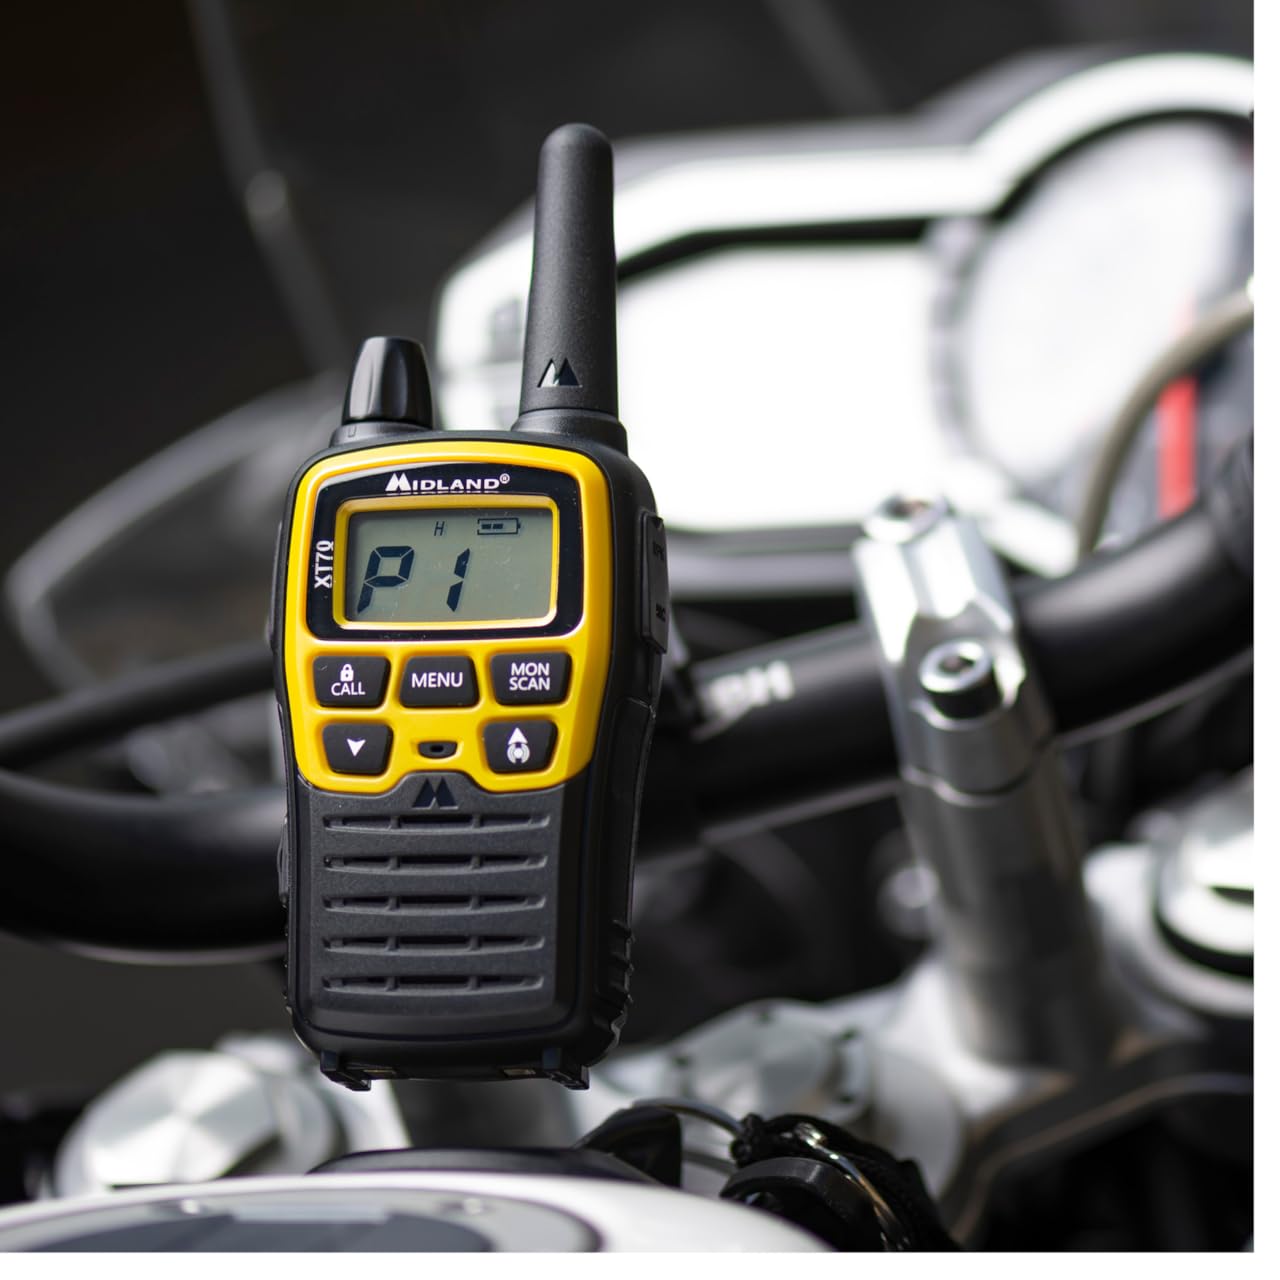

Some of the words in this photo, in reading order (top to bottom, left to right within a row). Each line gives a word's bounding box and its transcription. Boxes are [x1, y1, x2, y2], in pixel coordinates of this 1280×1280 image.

[434, 521, 445, 536] H
[510, 662, 550, 677] MON
[411, 671, 463, 688] MENU
[509, 677, 551, 692] SCAN
[331, 681, 365, 696] CALL
